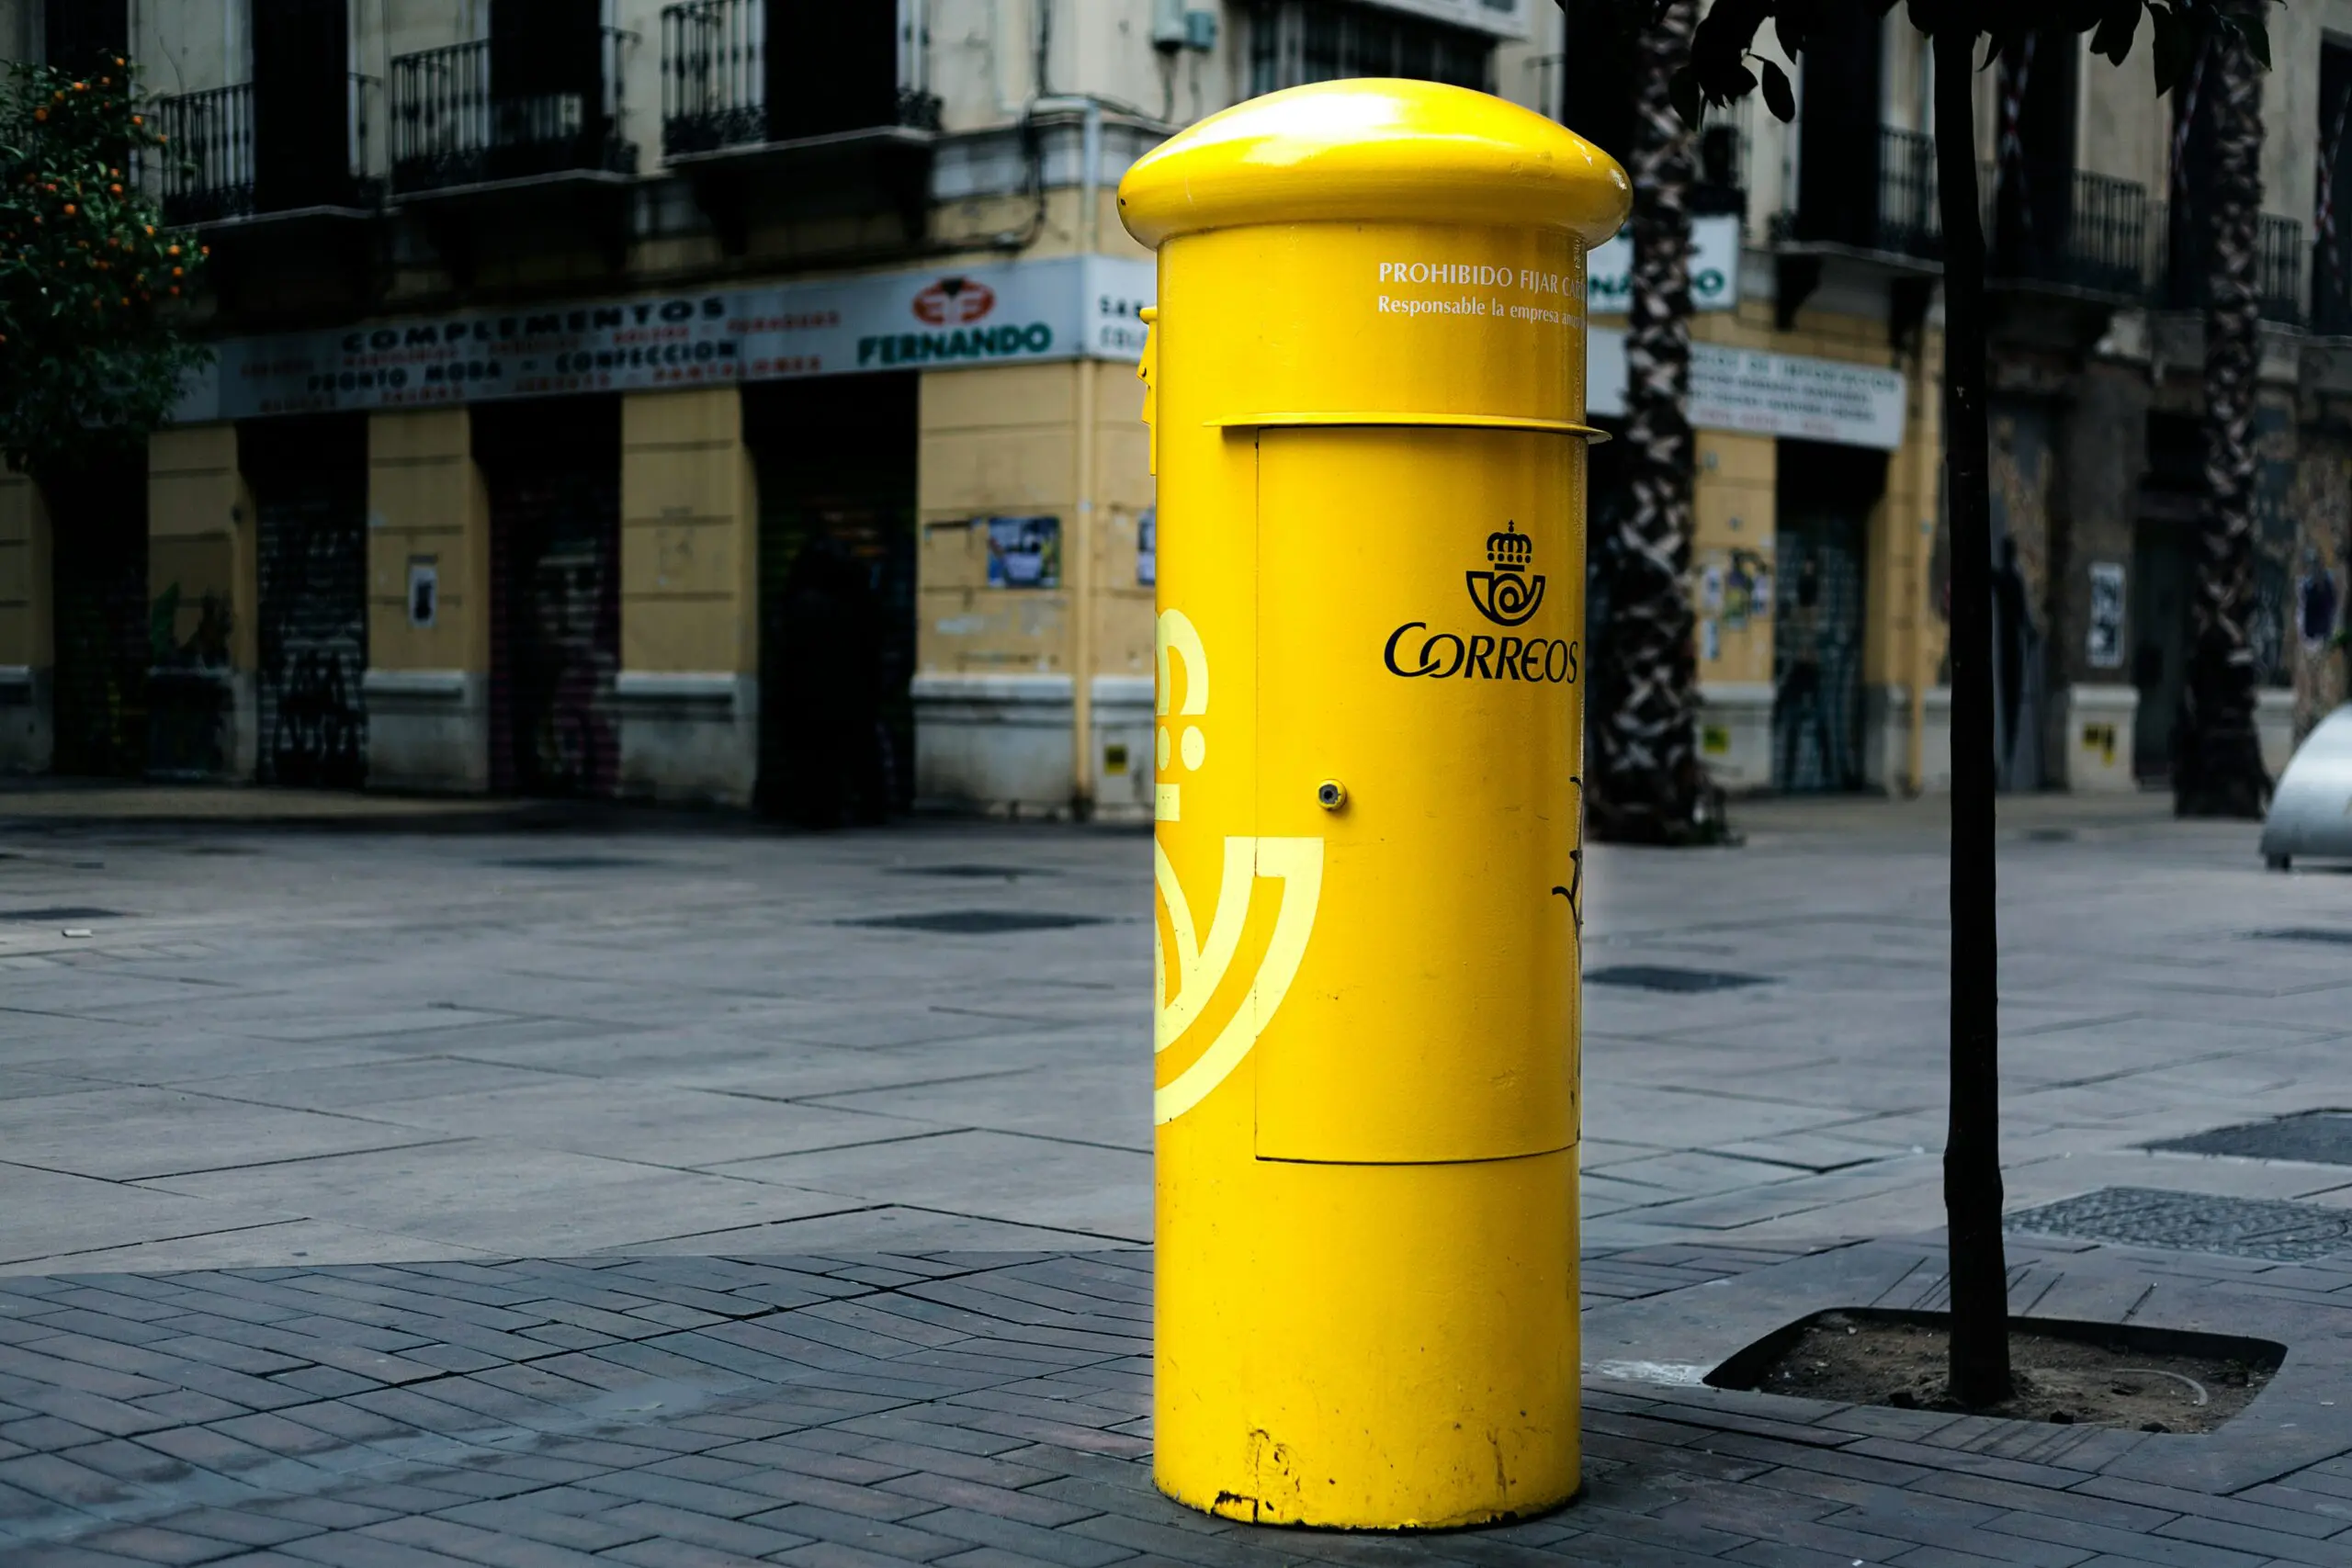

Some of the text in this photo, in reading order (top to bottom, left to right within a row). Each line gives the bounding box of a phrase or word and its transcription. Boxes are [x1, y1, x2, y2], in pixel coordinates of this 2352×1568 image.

[1378, 262, 1513, 288] PROHIBIDO
[1520, 269, 1558, 295] FIJAR
[341, 297, 726, 353] COMPLEMENTOS
[1377, 295, 1486, 317] Responsable
[1491, 298, 1505, 317] la
[1510, 307, 1559, 324] empresa
[556, 339, 738, 374] CONFECCION
[859, 322, 1053, 367] FERNANDO
[1384, 621, 1579, 683] CORREOS
